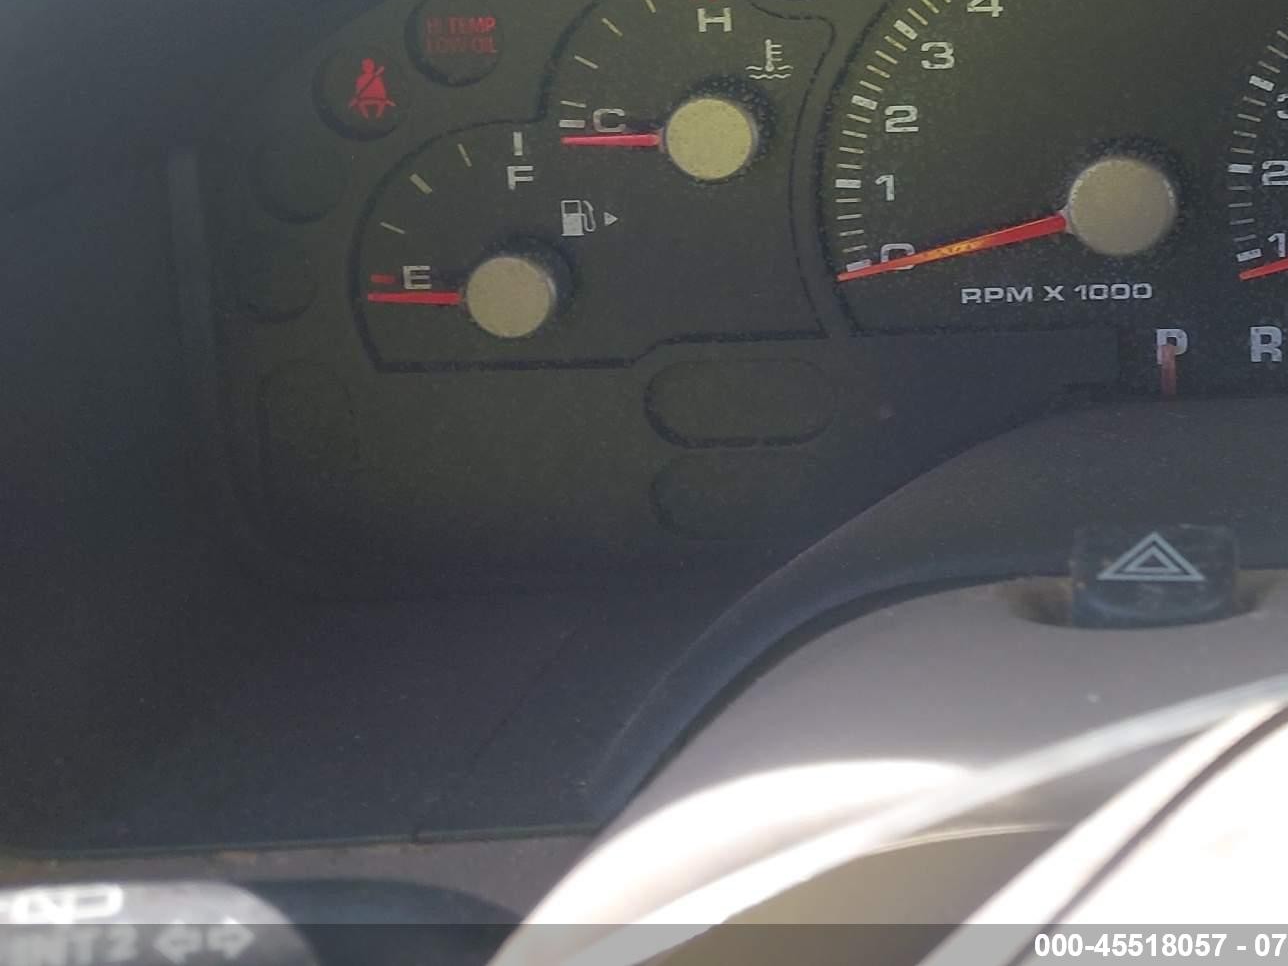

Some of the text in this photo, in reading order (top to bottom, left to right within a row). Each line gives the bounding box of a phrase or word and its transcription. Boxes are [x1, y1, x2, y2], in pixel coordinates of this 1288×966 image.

[698, 8, 731, 32] H
[921, 42, 954, 69] 3
[594, 109, 625, 132] C
[885, 106, 918, 132] 2
[507, 166, 533, 189] F
[875, 175, 894, 200] 1
[881, 243, 914, 269] 0
[403, 266, 432, 289] E
[962, 284, 1152, 303] RPM X 1000
[1156, 329, 1187, 367] P
